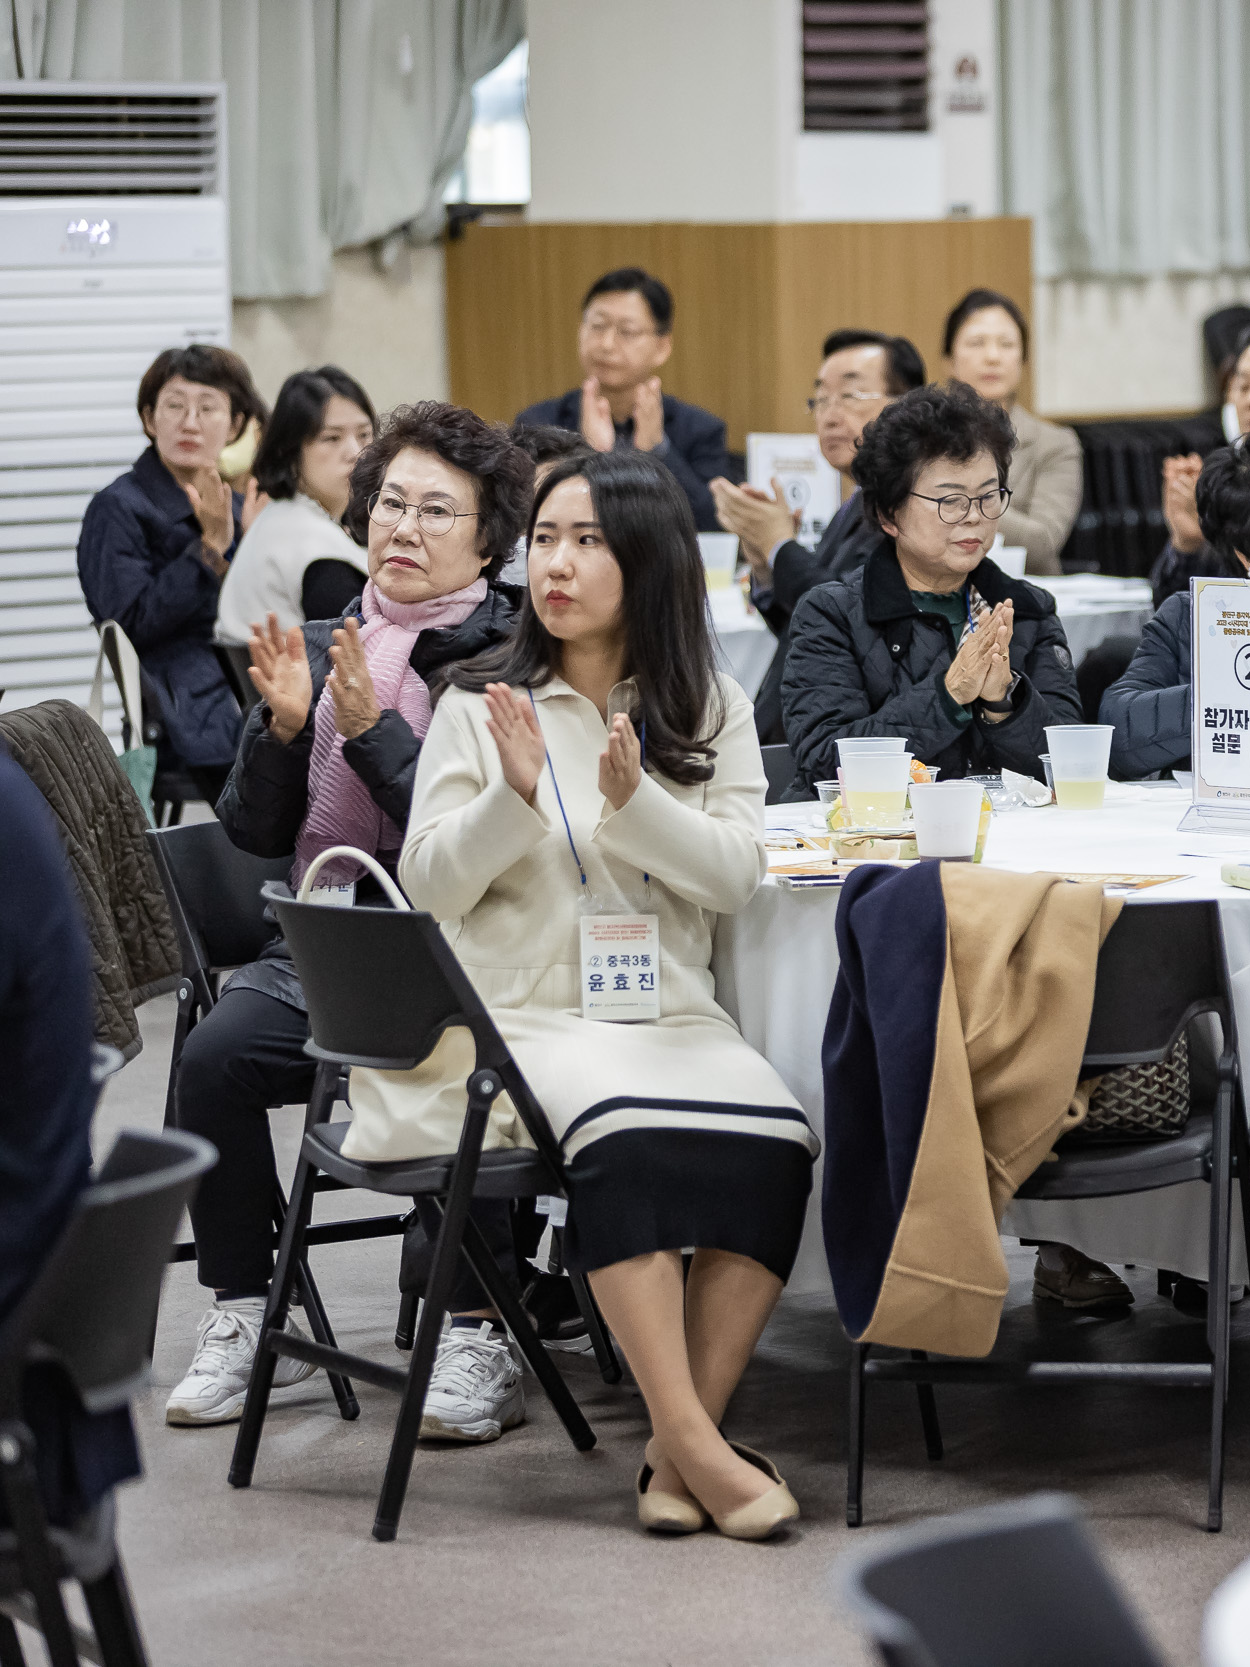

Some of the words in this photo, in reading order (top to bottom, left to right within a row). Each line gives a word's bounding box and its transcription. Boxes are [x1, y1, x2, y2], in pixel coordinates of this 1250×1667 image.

[1204, 707, 1250, 730] 참가자
[1212, 732, 1241, 754] 설문
[607, 954, 652, 967] 중곡3동
